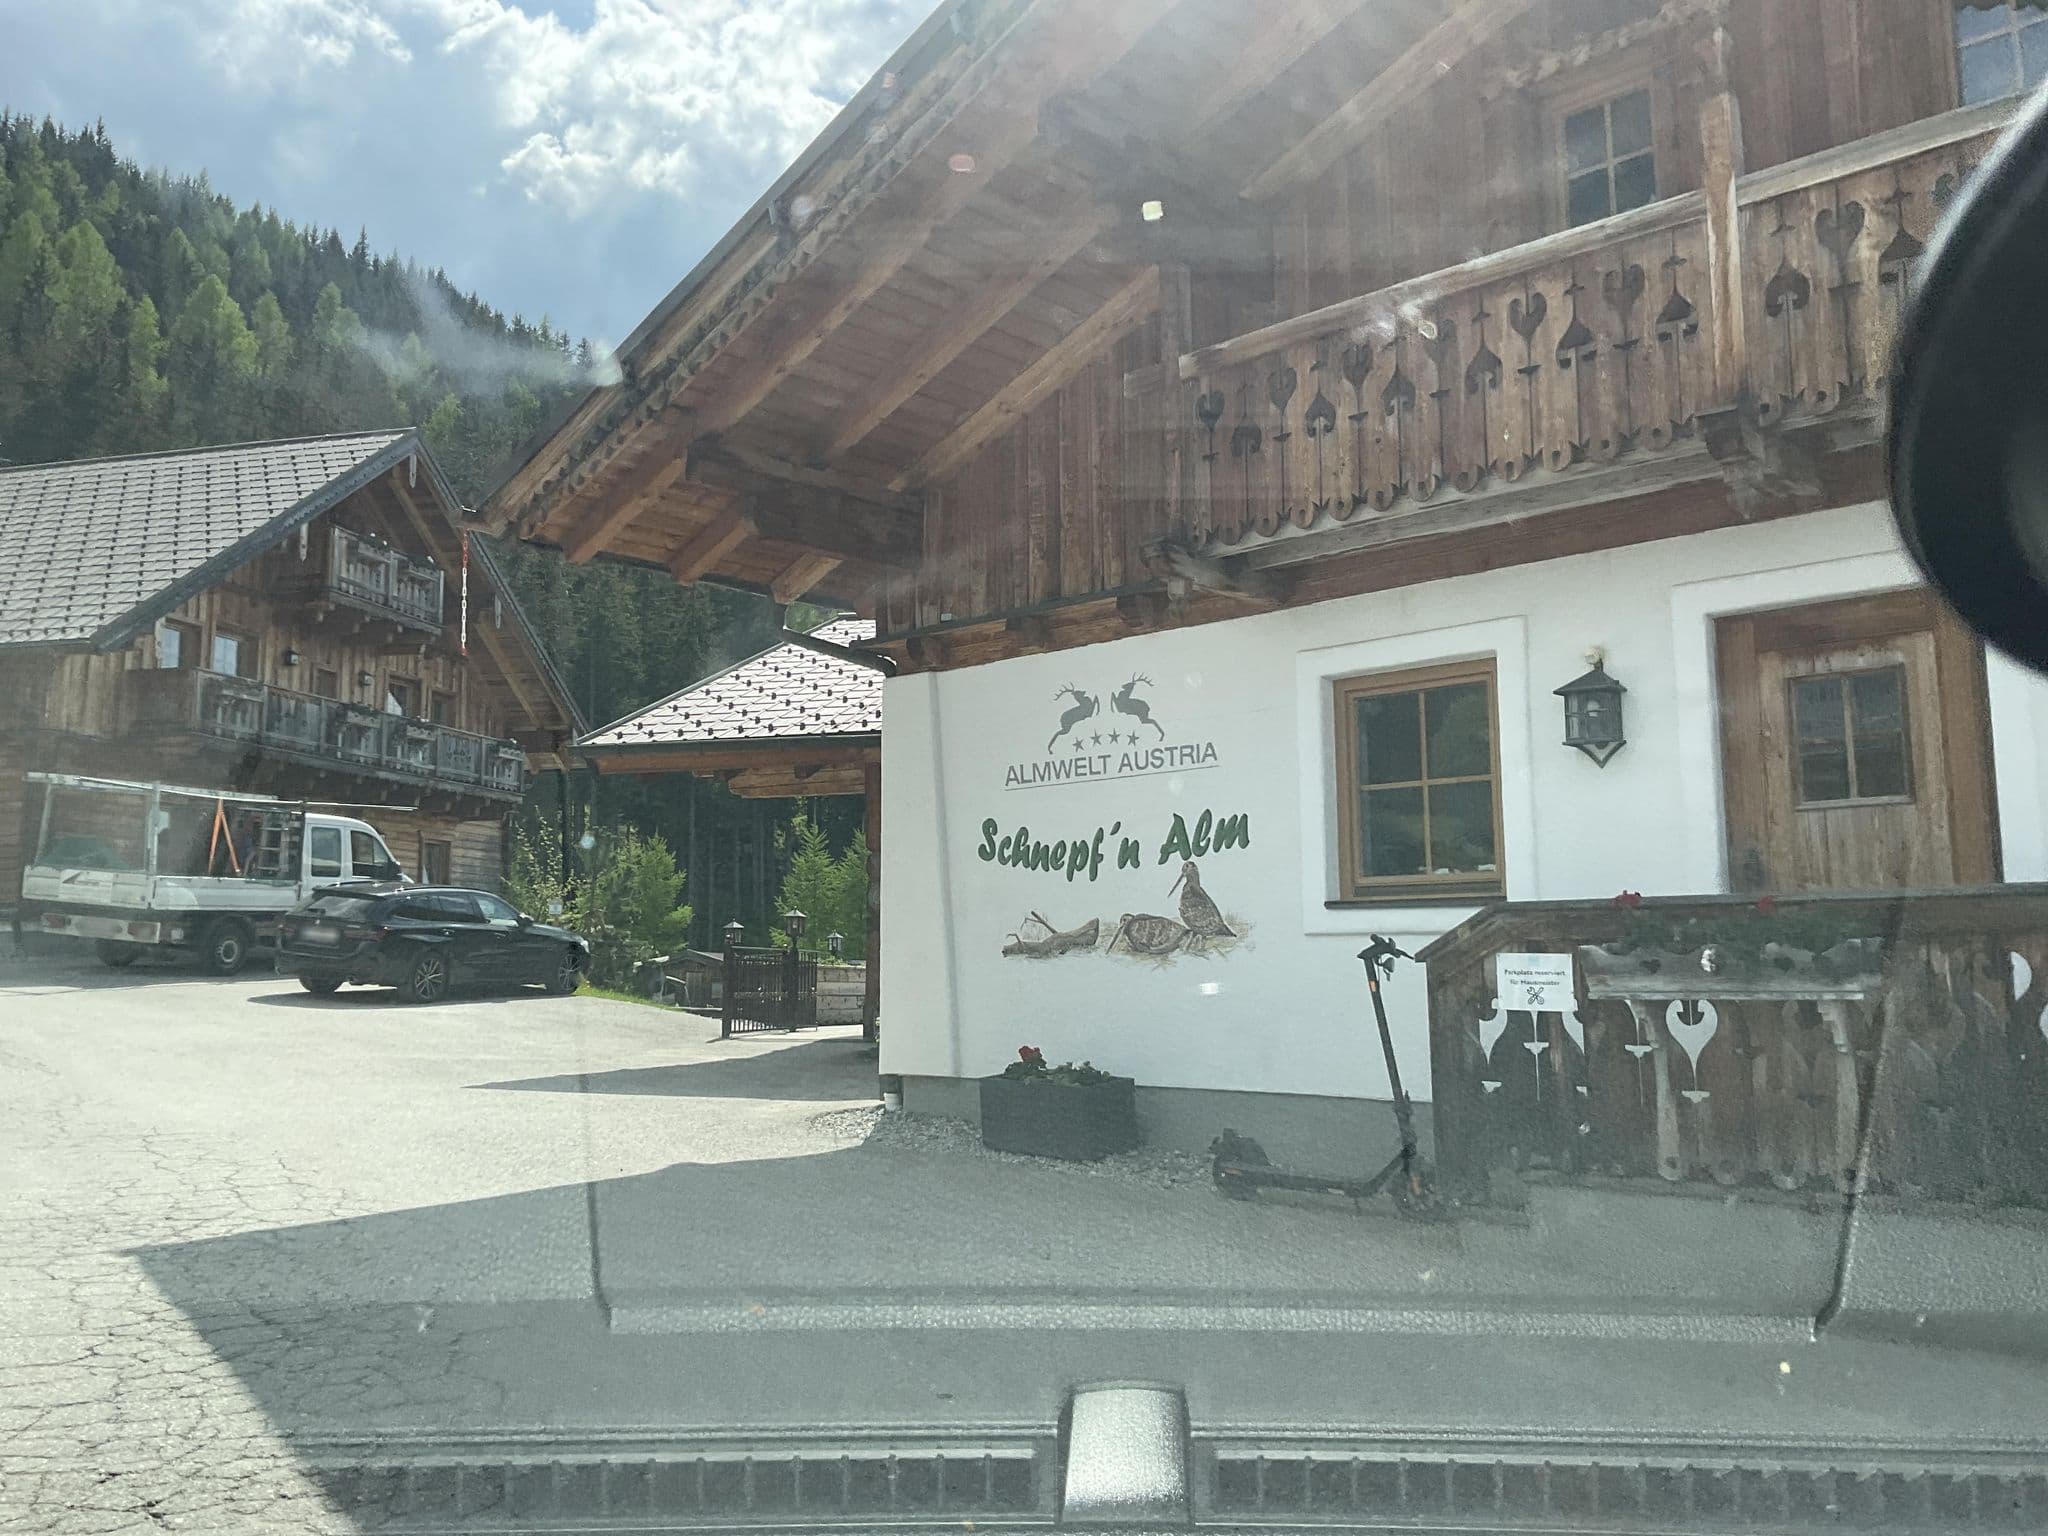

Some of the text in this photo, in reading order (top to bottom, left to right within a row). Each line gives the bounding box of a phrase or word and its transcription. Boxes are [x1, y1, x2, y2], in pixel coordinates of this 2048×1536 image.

[1005, 742, 1218, 787] ALMWELT AUSTRIA
[1157, 808, 1250, 866] Alm
